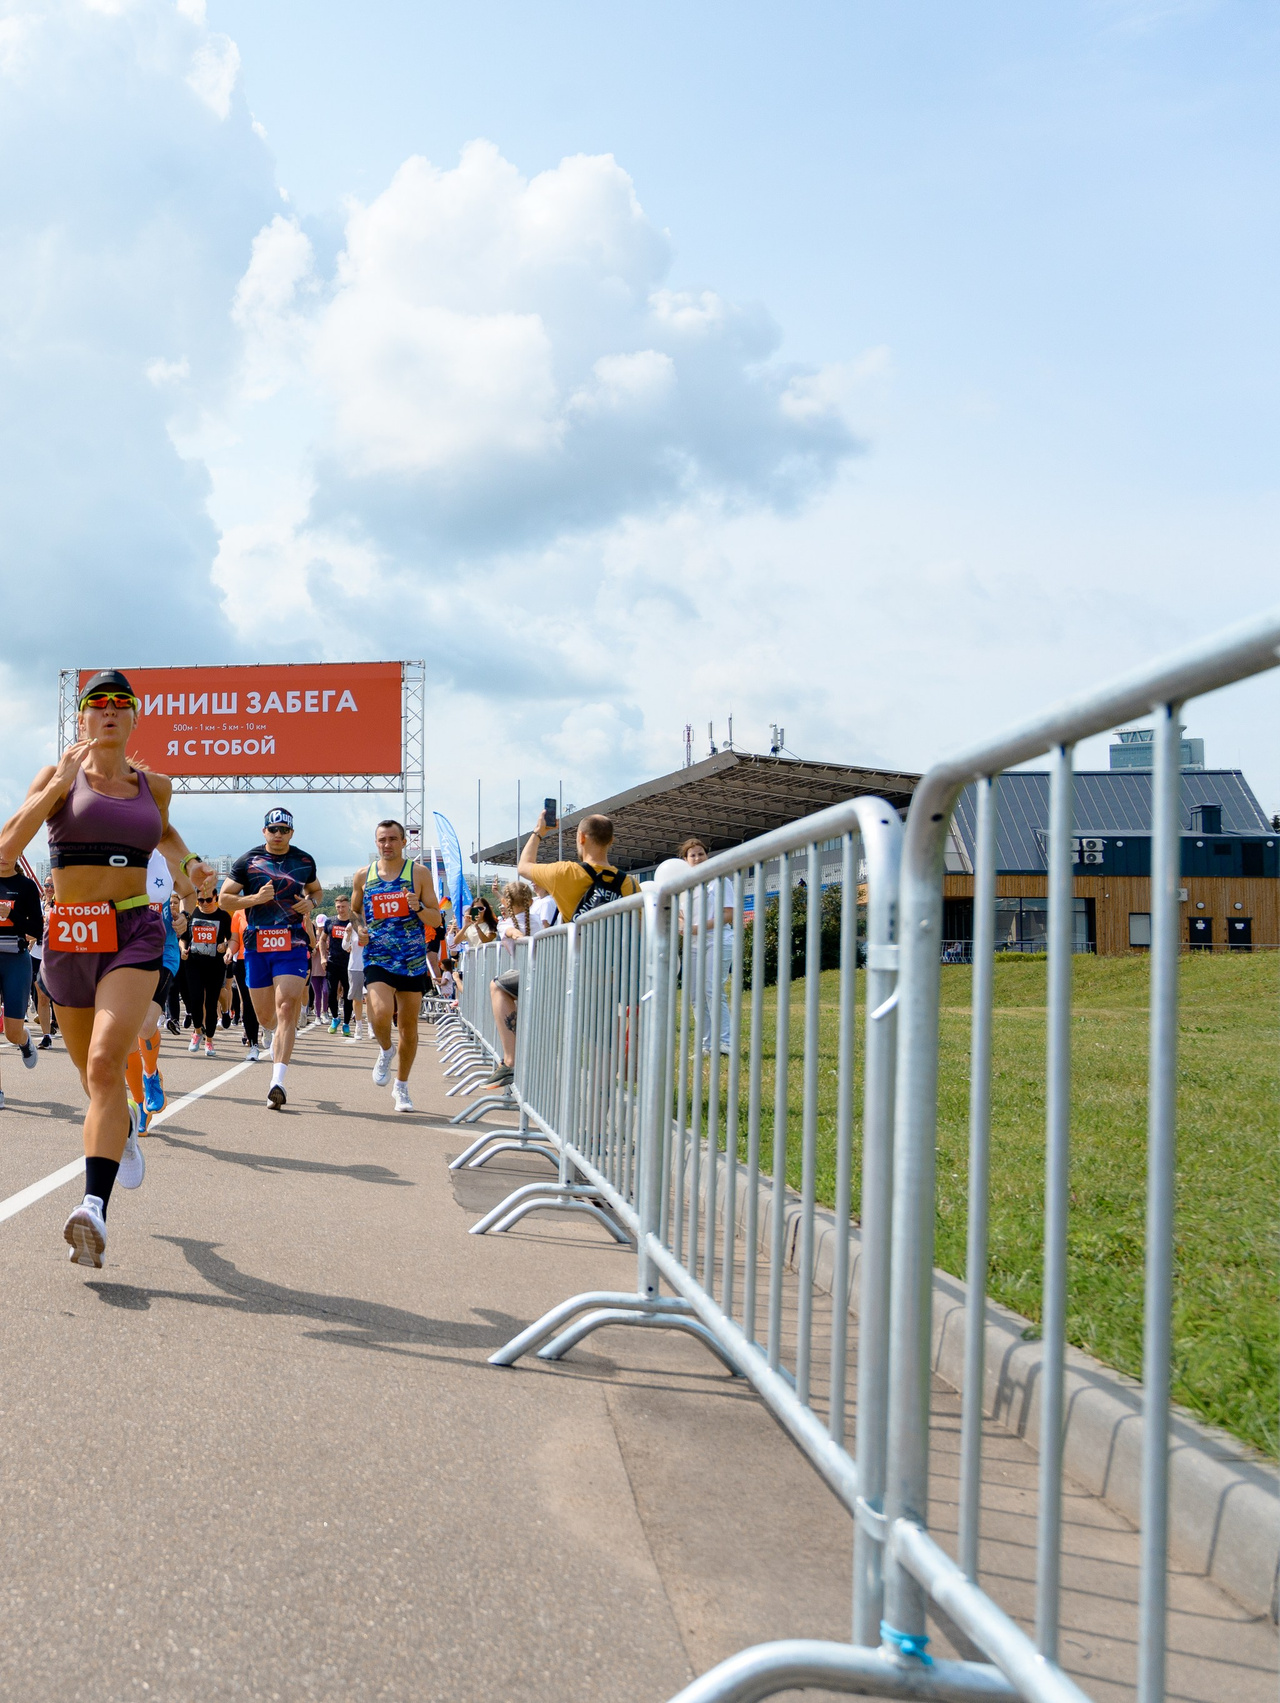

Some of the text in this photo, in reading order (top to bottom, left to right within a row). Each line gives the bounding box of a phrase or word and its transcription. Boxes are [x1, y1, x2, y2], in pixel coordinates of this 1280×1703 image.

[245, 689, 359, 714] ЗАБЕГА
[173, 723, 193, 731] 500м
[222, 723, 227, 731] 5
[246, 722, 255, 730] 10
[166, 735, 276, 756] Я С ТОБОЙ
[383, 892, 405, 900] ТОБОЙ
[58, 906, 66, 916] С
[66, 902, 110, 916] ТОБОЙ
[379, 901, 400, 914] 119
[57, 921, 99, 943] 201
[197, 932, 212, 940] 198
[262, 937, 285, 948] 200
